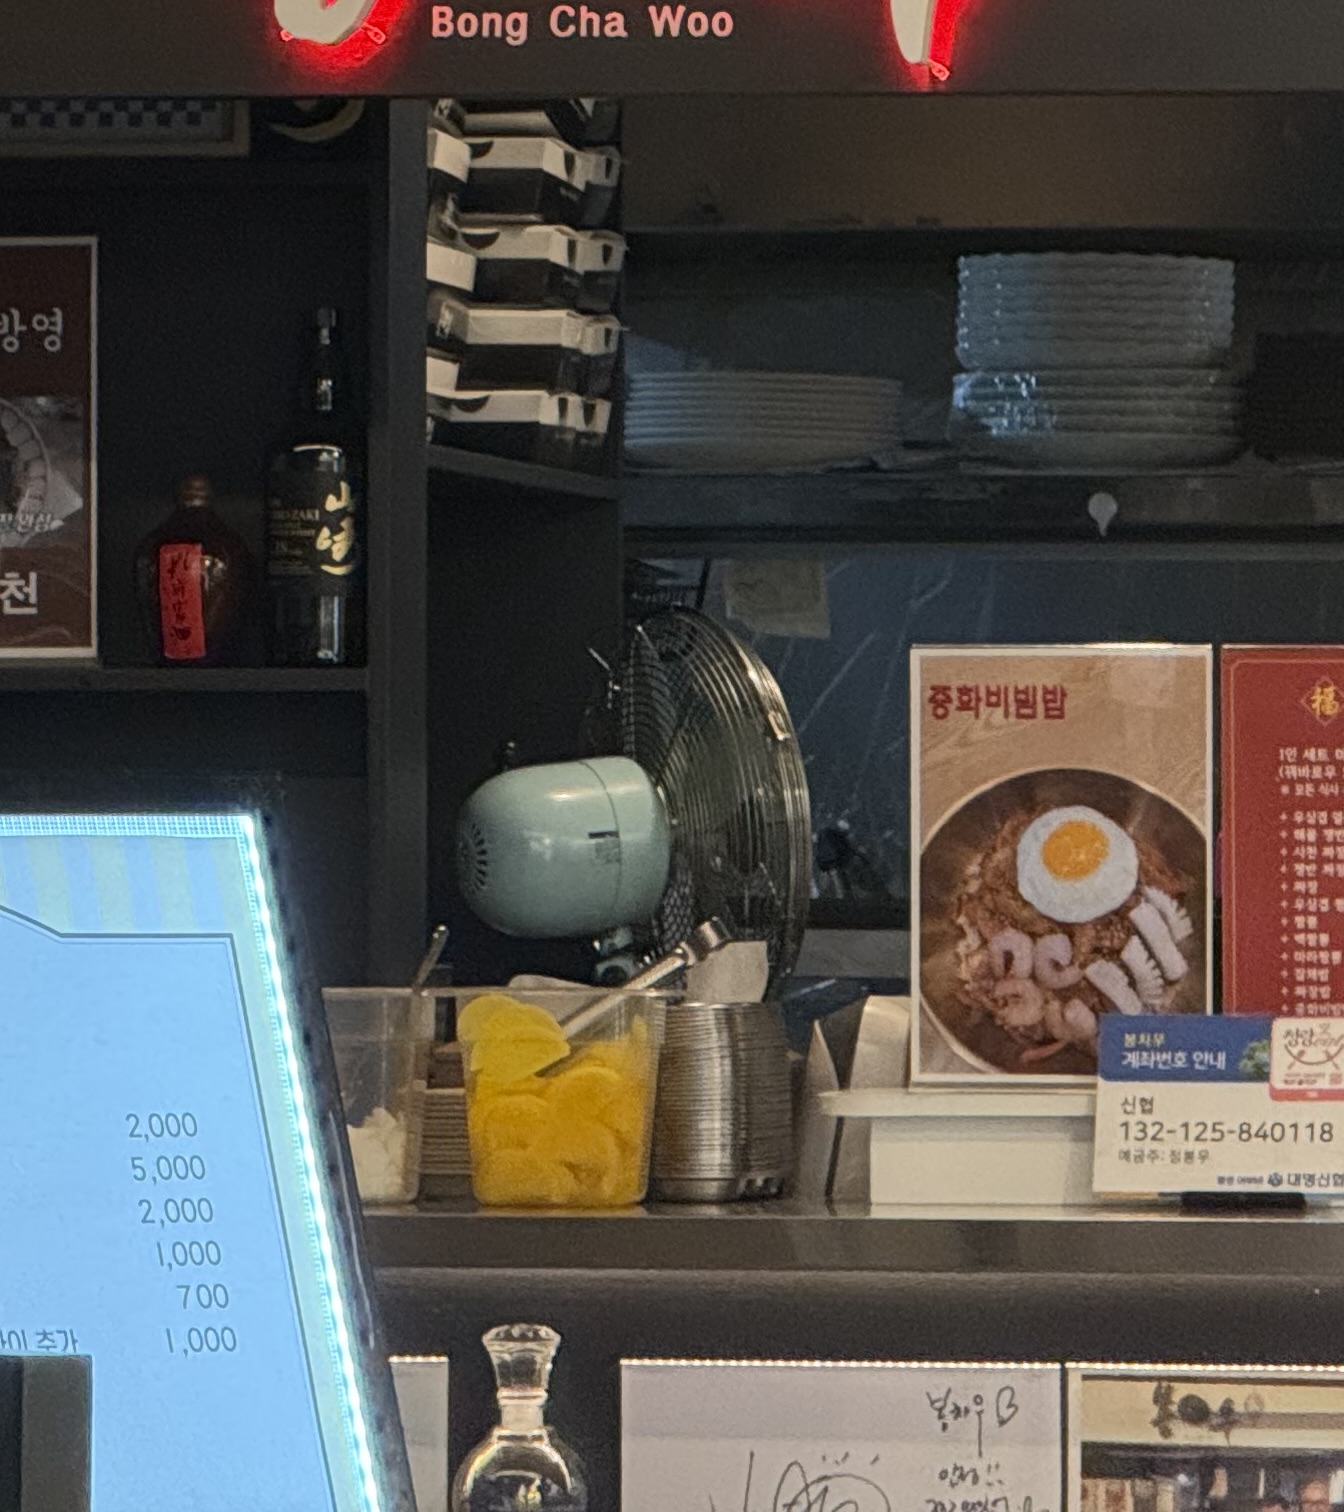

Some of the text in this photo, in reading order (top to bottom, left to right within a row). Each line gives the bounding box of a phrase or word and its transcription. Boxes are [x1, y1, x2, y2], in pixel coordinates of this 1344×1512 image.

[430, 4, 734, 45] Bong Cha Woo
[928, 684, 1067, 720] 중화비빔밥
[1122, 1050, 1226, 1070] 계좌번호 안내
[1121, 1096, 1154, 1115] 신협
[125, 1112, 198, 1142] 2,000
[1119, 1120, 1334, 1143] 132-125-840118
[131, 1155, 205, 1185] 5,000
[137, 1197, 214, 1228] 2,000
[156, 1240, 221, 1271] 1,000
[177, 1283, 229, 1309] 700
[166, 1327, 237, 1357] 1,000
